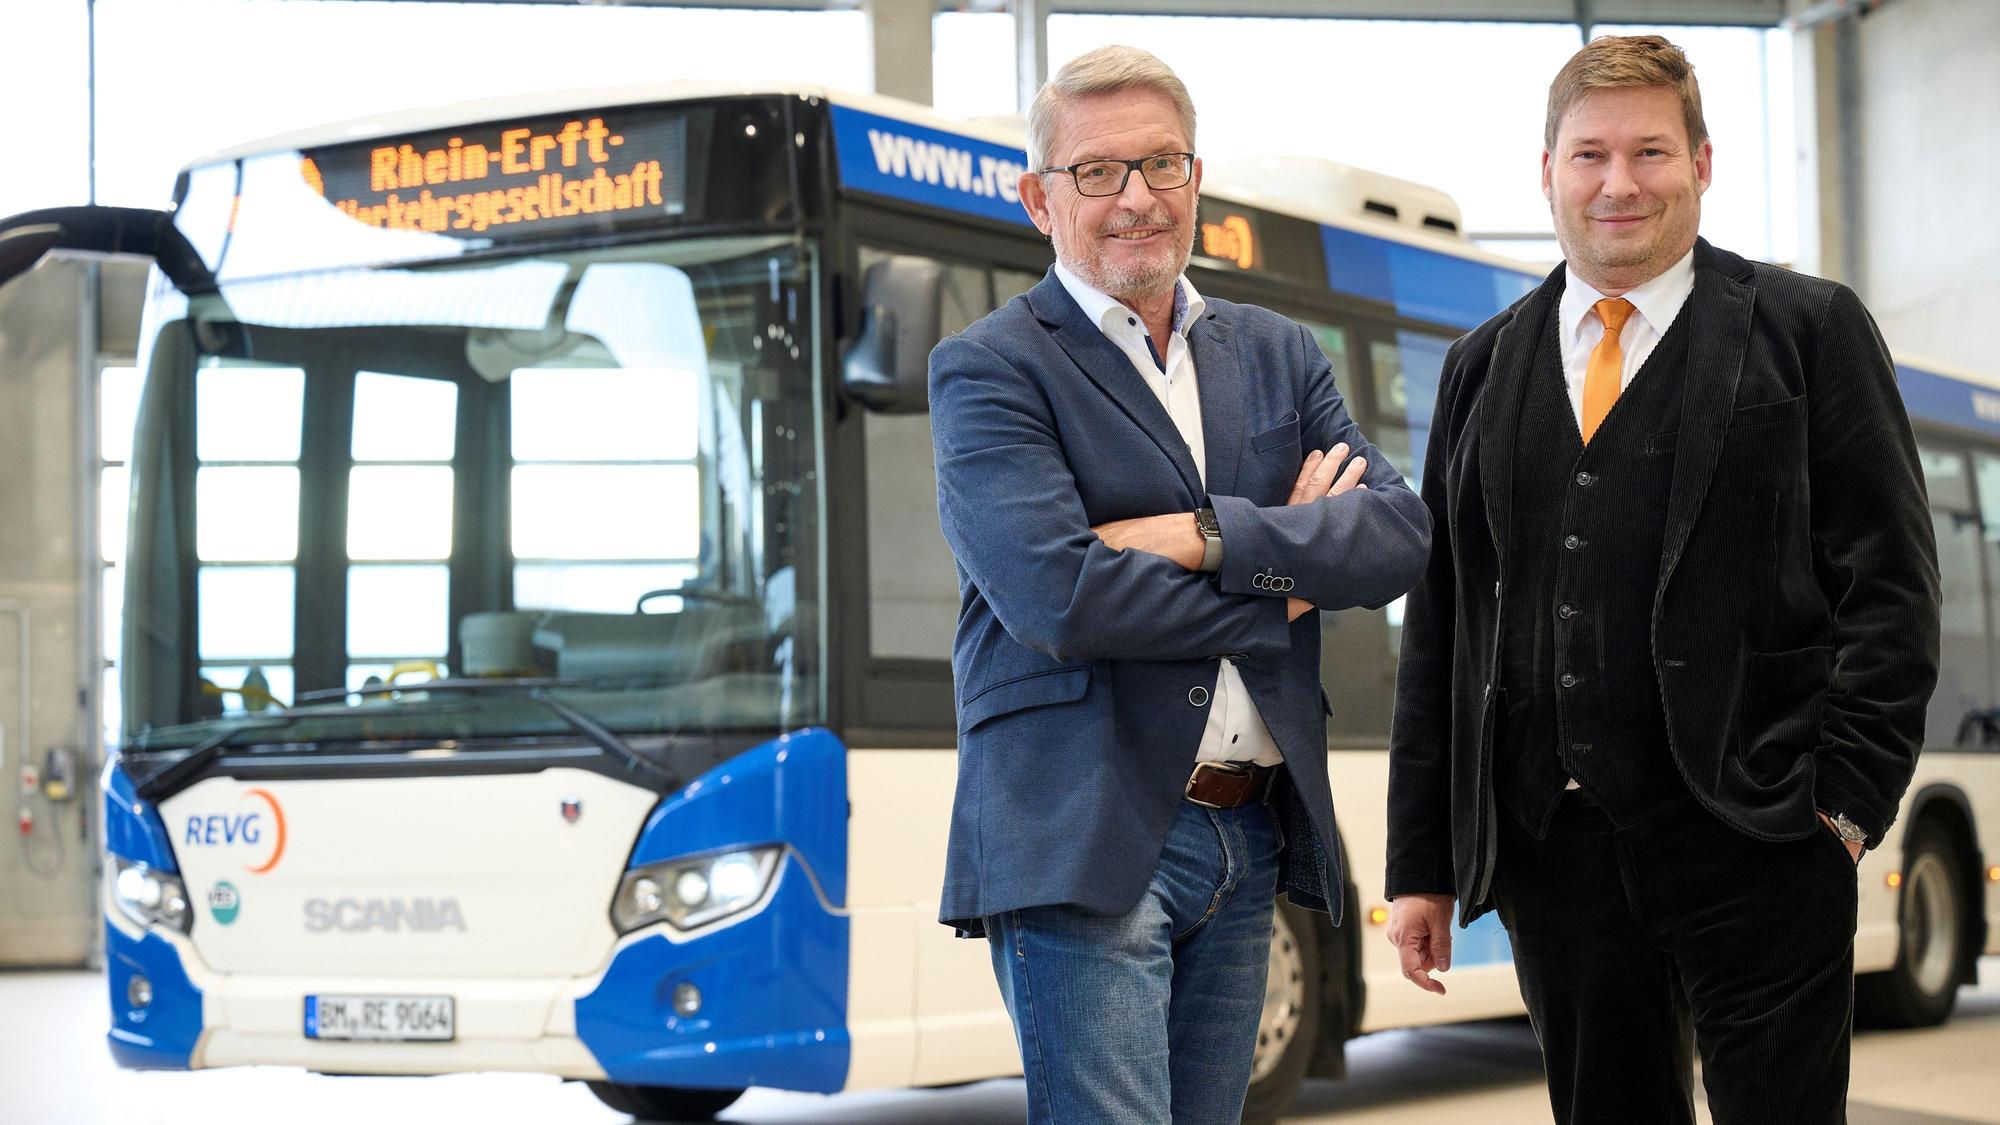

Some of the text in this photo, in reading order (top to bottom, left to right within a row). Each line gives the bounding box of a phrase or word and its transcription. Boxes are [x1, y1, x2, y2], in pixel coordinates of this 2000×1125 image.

[371, 118, 624, 191] Rhein-Erft-
[185, 813, 262, 845] REVG
[303, 896, 468, 934] SCANIA
[320, 1001, 347, 1030] BM
[363, 1001, 388, 1030] RE
[397, 1001, 451, 1031] 9064
